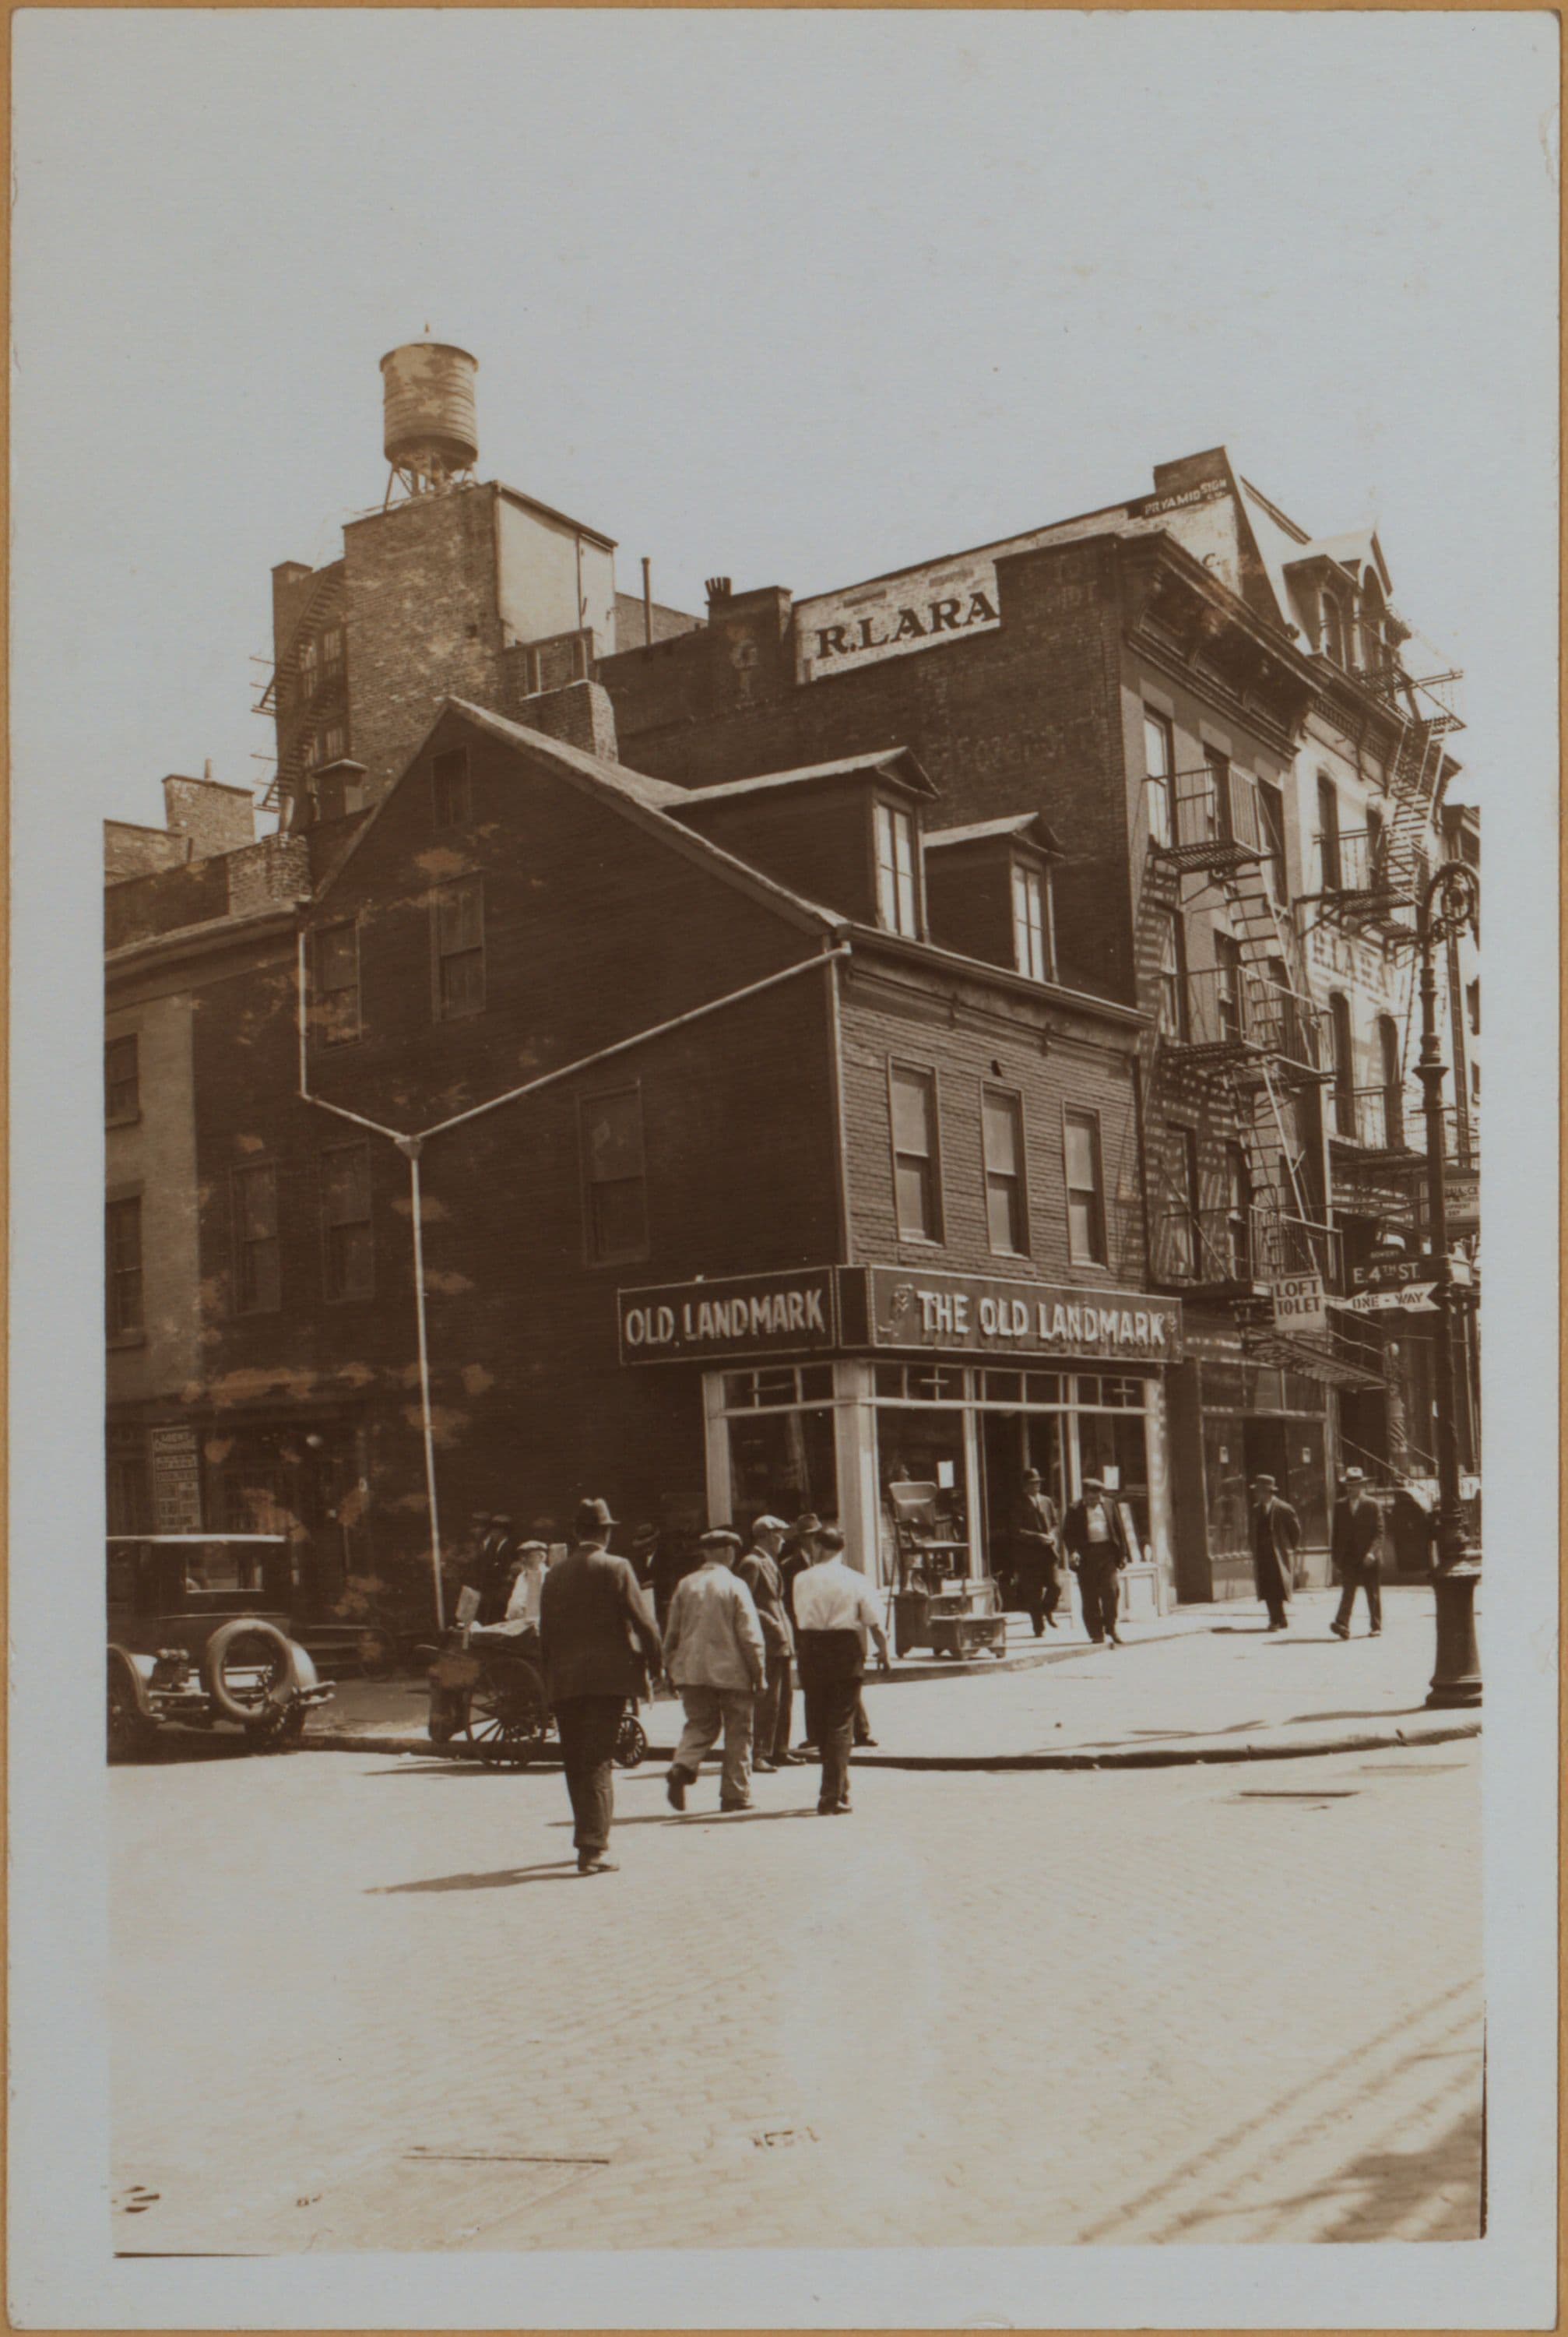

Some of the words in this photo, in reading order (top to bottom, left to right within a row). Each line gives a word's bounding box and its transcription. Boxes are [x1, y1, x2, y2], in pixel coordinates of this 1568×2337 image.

[1275, 1279, 1320, 1298] LOFT
[1277, 1299, 1293, 1315] TO
[1294, 1296, 1320, 1314] LET
[1352, 1295, 1380, 1309] ONE
[1394, 1292, 1424, 1306] WAY
[683, 1289, 826, 1342] LANDMARK
[916, 1290, 970, 1335] THE
[978, 1297, 1029, 1337] OLD
[1038, 1300, 1166, 1346] LANDMARK
